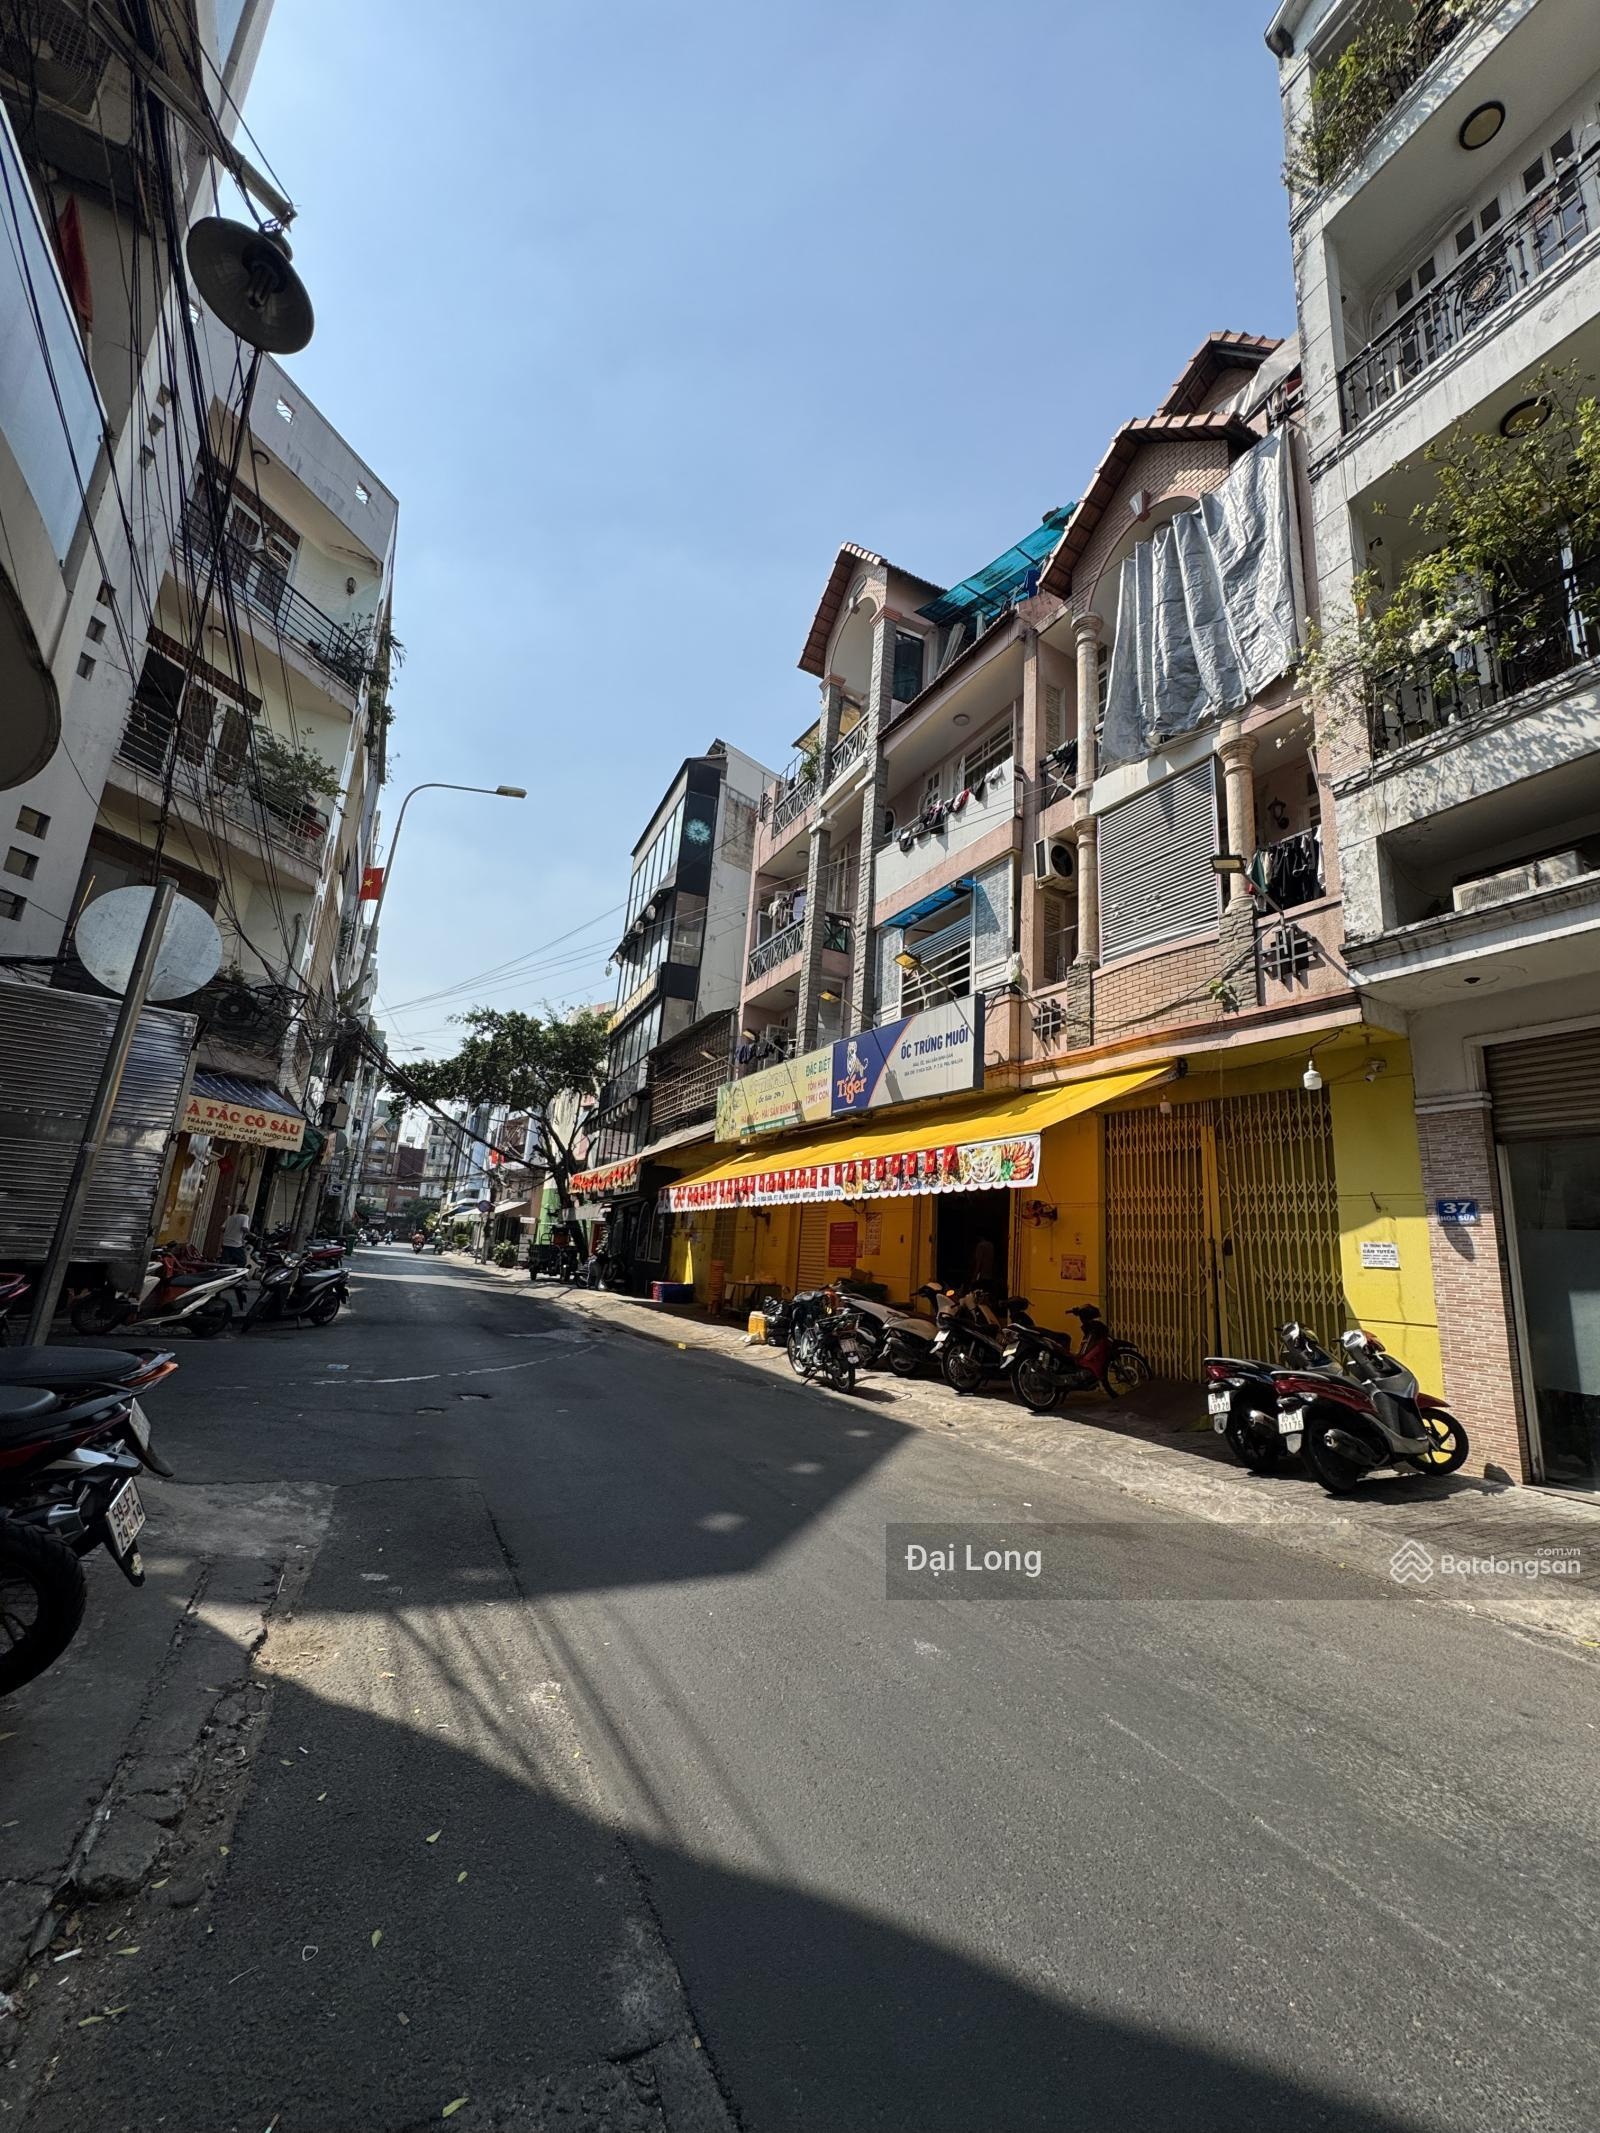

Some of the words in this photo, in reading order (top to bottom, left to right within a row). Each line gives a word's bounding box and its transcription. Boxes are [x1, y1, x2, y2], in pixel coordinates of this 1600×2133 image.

[901, 1039, 912, 1060] ỐC
[836, 1075, 868, 1104] Tiger
[244, 1113, 266, 1128] CÔ
[1443, 1202, 1471, 1214] 37
[1458, 1213, 1476, 1222] SỮA
